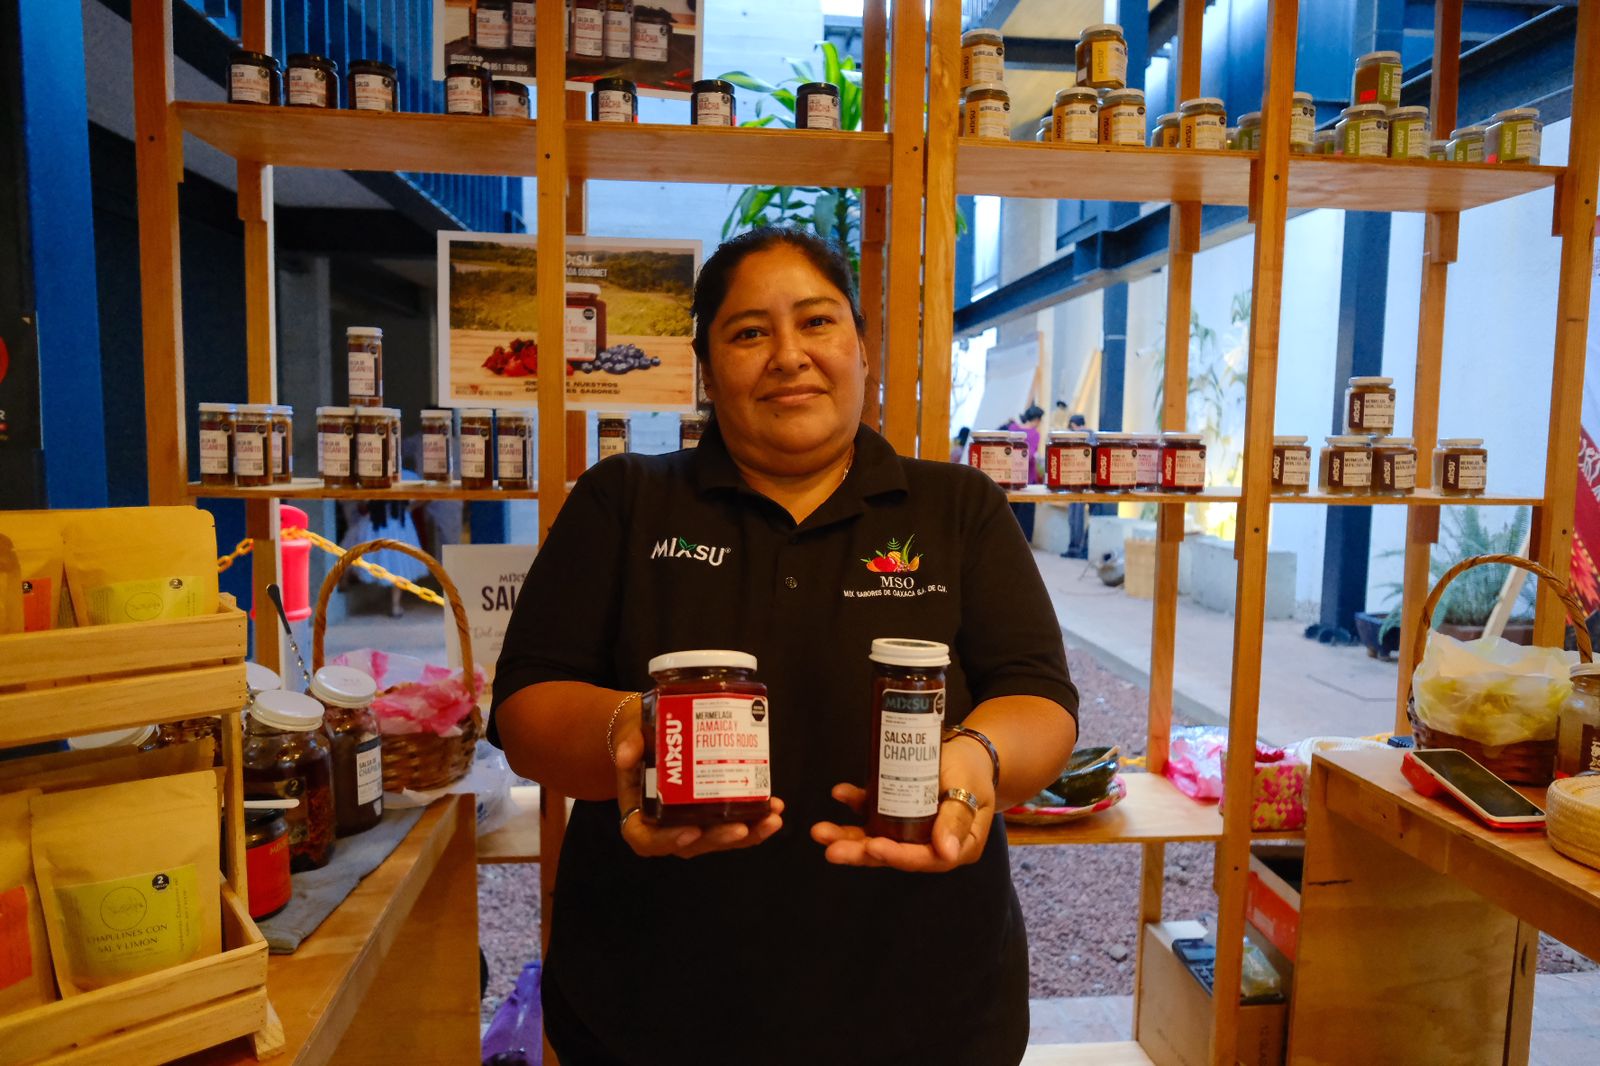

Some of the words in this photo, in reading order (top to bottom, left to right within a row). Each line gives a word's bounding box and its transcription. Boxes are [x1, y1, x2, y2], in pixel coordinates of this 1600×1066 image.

[500, 573, 526, 582] MIXS
[880, 576, 914, 589] MSO
[856, 590, 882, 598] SABORES
[892, 589, 916, 597] OAXACA
[885, 697, 930, 710] MIXSU
[696, 720, 733, 732] JAMAICA
[696, 733, 735, 748] FRUTOS
[736, 734, 758, 748] ROJOS
[884, 730, 912, 744] SALSA
[915, 733, 926, 744] DE
[146, 923, 168, 934] CON
